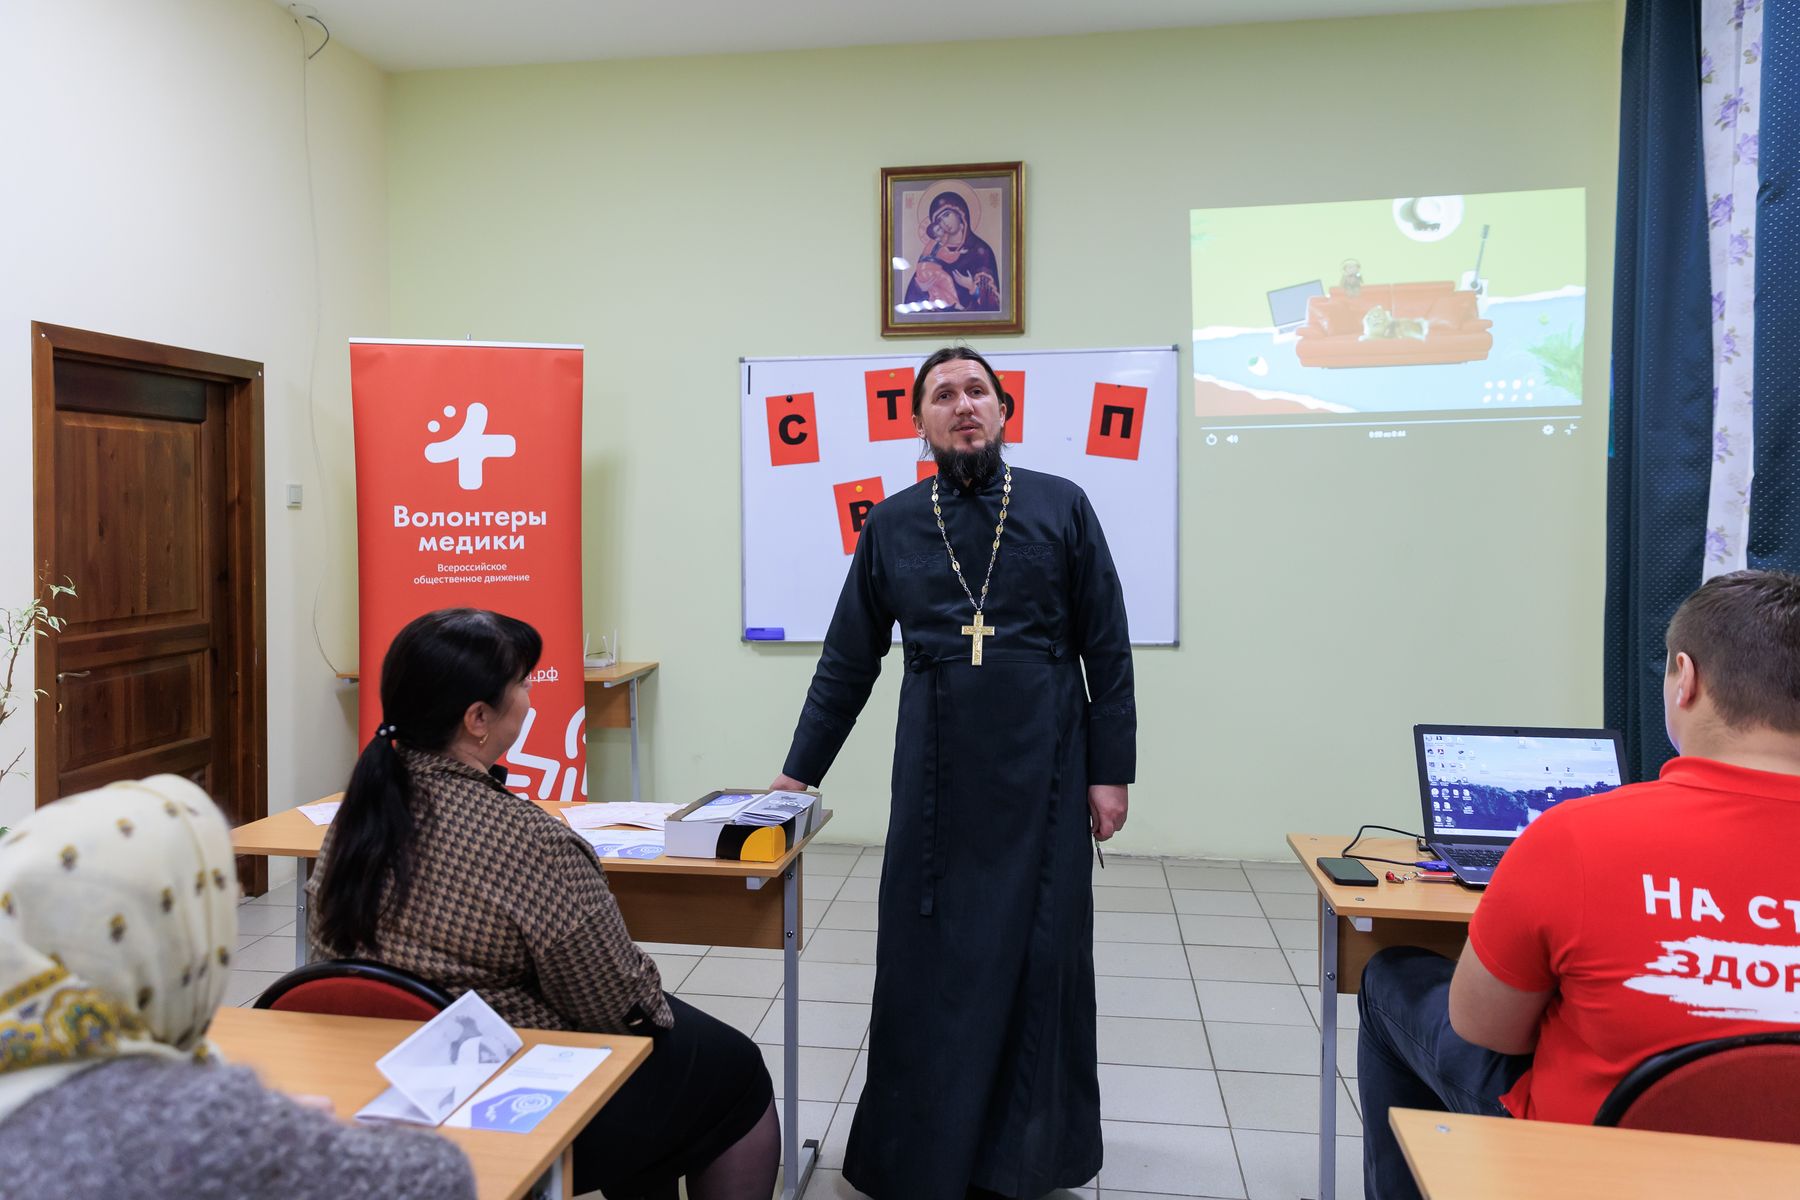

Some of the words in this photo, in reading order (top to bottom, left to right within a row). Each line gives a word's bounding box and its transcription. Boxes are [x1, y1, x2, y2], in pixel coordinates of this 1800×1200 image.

[778, 414, 808, 446] С
[876, 388, 906, 420] Т
[1099, 404, 1134, 439] П
[393, 505, 547, 533] Волонтеры
[418, 534, 526, 555] медики
[413, 575, 483, 586] общественное
[483, 573, 531, 584] движение
[437, 562, 508, 574] Всероссийское
[1642, 873, 1726, 923] НА
